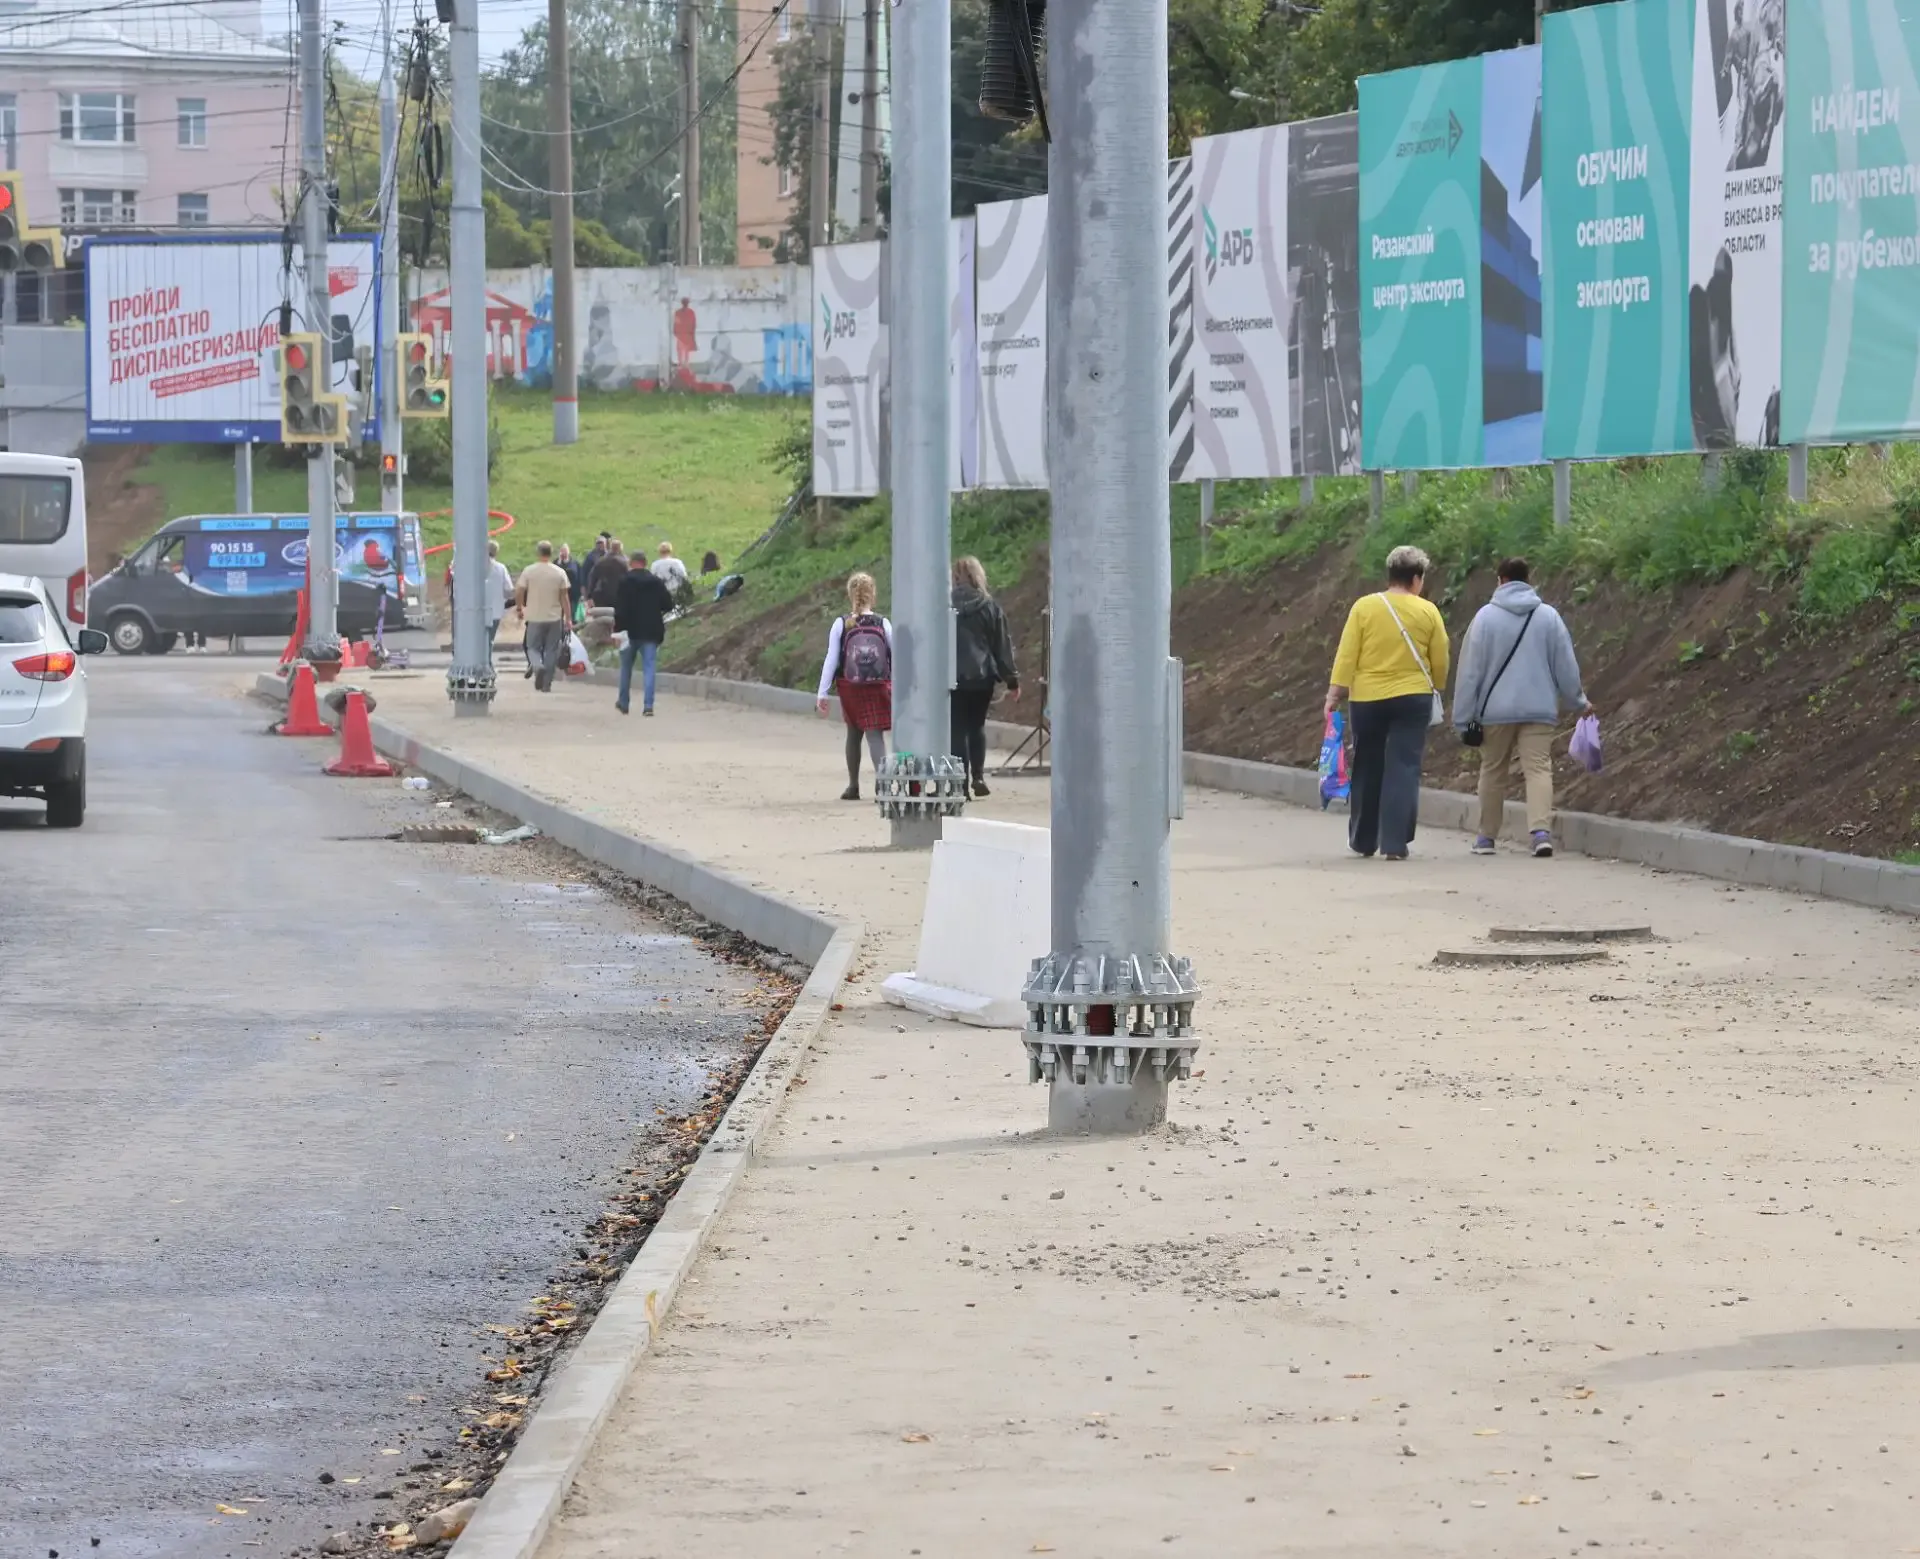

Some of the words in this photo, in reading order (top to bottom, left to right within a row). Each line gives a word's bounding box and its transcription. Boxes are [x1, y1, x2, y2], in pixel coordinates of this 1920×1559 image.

[1811, 84, 1900, 136] НАЙДЕМ
[1576, 145, 1648, 187] ОБУЧИМ
[1725, 181, 1743, 200] ДНИ
[1576, 214, 1644, 248] основам
[1724, 205, 1764, 227] БИЗНЕСА
[1765, 205, 1770, 221] В
[1372, 226, 1435, 260] Рязанский
[1724, 233, 1766, 254] ОБЛАСТИ
[1808, 241, 1831, 272] за
[108, 286, 180, 325] ПРОЙДИ
[1373, 284, 1407, 311] центр
[1410, 276, 1465, 308] экспорта
[1576, 274, 1650, 312] экспорта
[108, 310, 210, 353] БЕСПЛАТНО
[210, 542, 225, 553] 90
[228, 542, 240, 553] 15
[242, 542, 254, 553] 15
